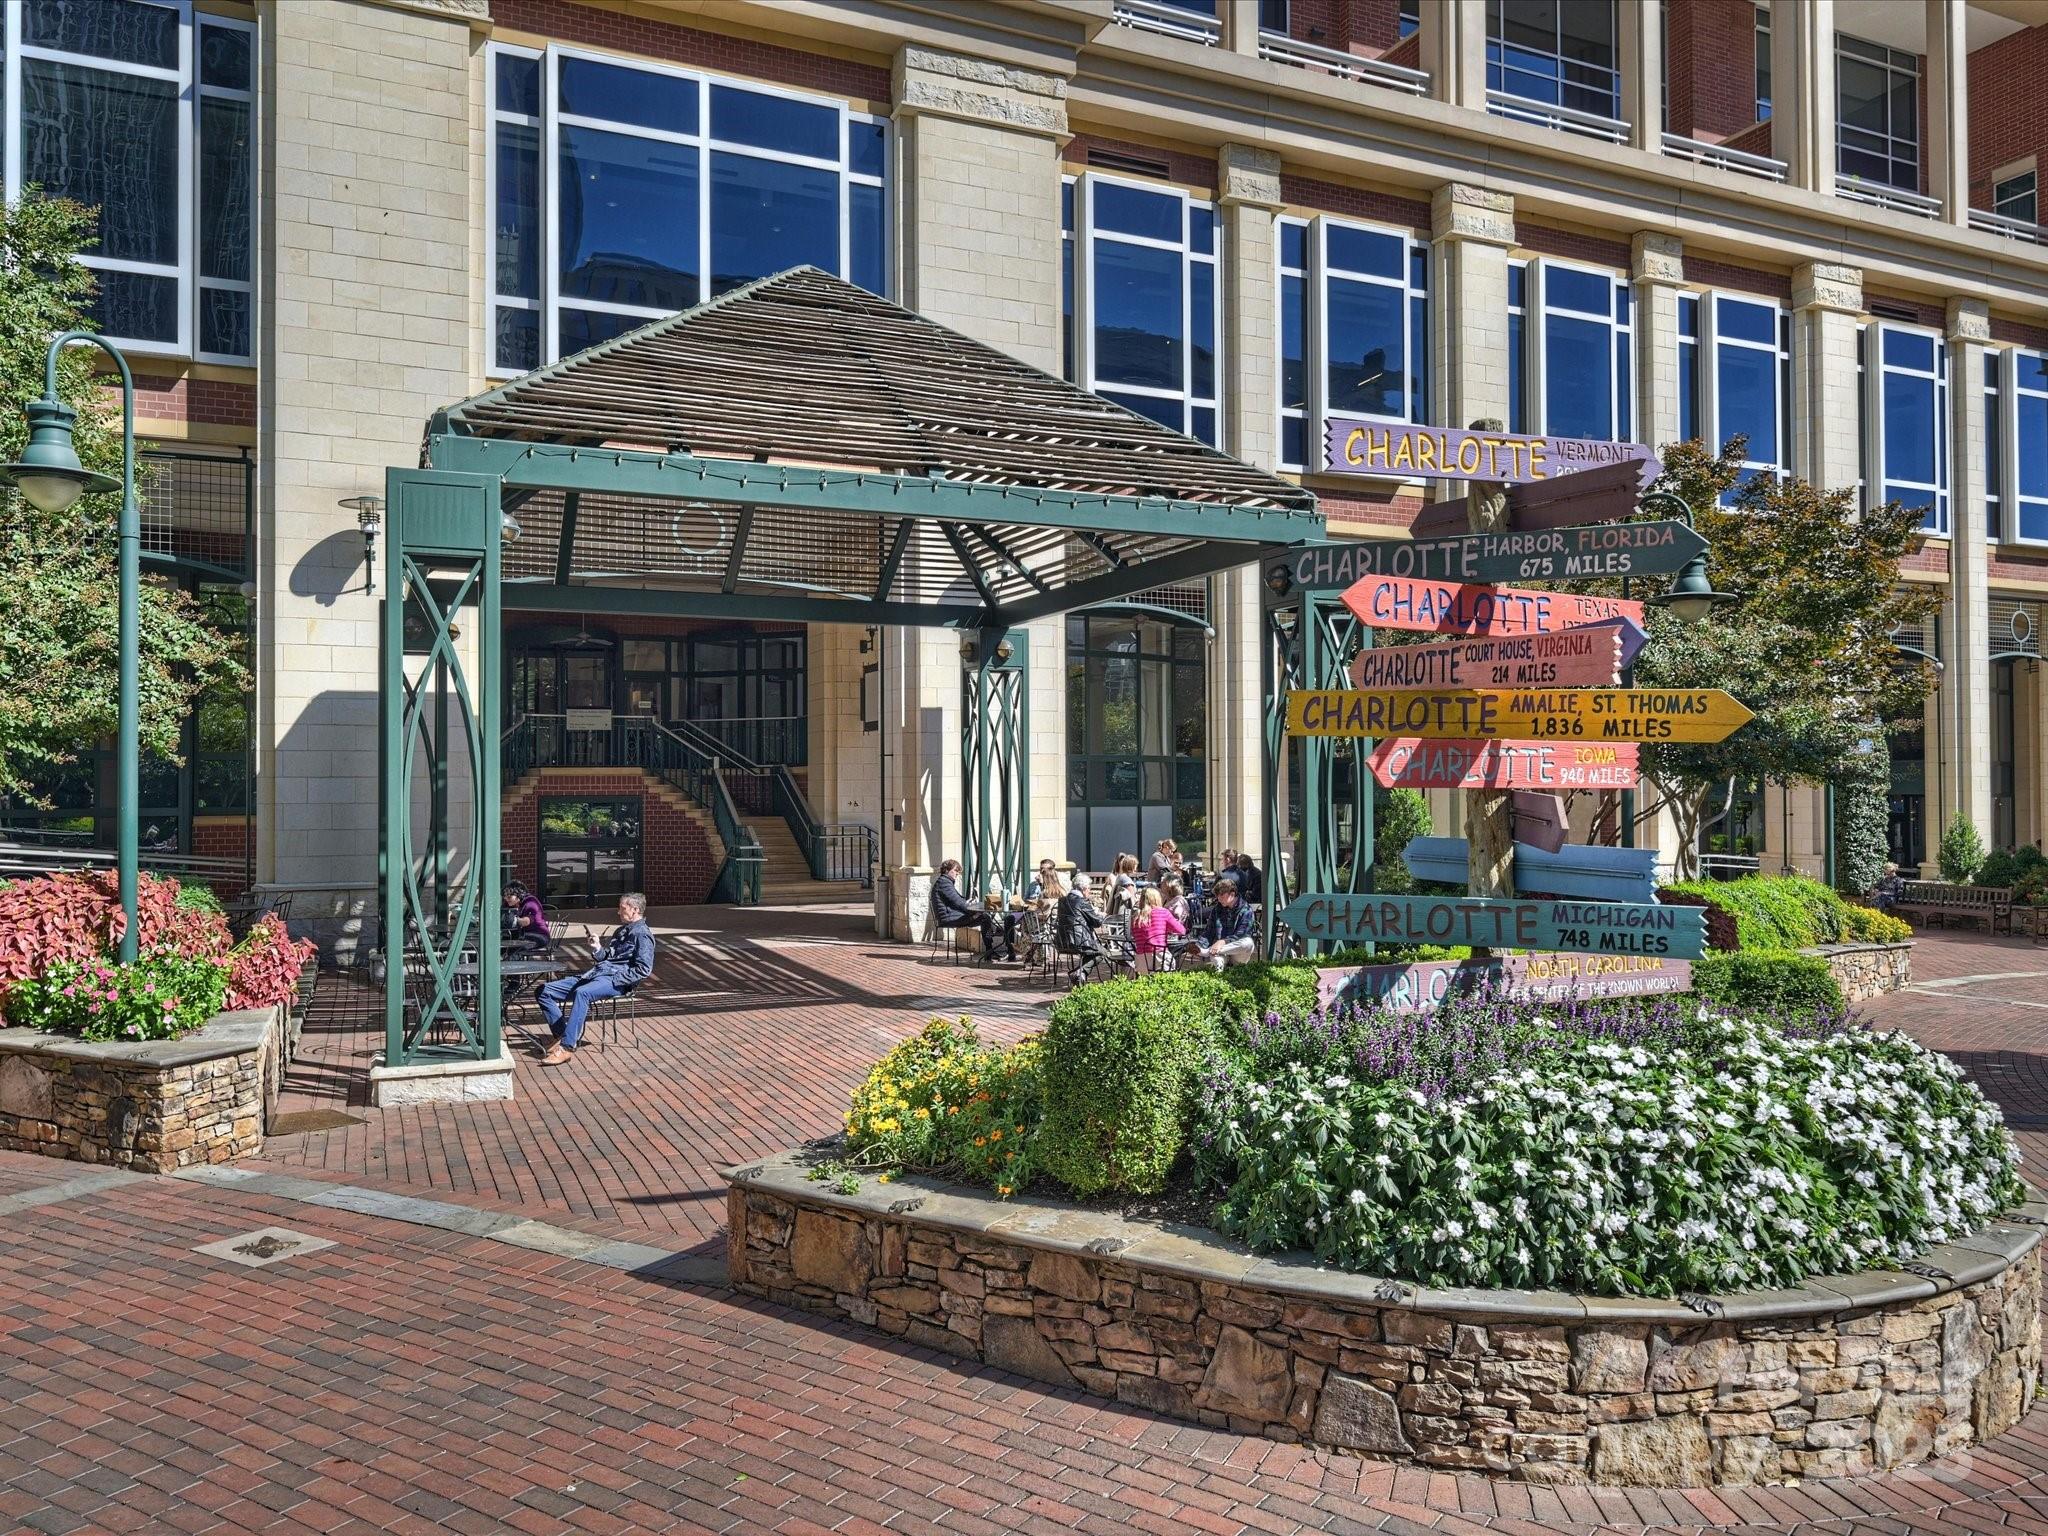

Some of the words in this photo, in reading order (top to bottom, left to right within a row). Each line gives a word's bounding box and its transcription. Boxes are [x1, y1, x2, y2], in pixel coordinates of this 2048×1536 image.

[1345, 426, 1547, 480] CHARLOTTE
[1556, 440, 1635, 463] VERMONT
[1296, 537, 1480, 585] CHARLOTTE
[1483, 533, 1570, 557] HARBOR,
[1578, 526, 1675, 551] FLORIDA
[1519, 557, 1554, 578] 675
[1565, 553, 1632, 576] MILES
[1373, 583, 1552, 634] CHARLOTTE
[1574, 598, 1620, 618] TEXAS
[1363, 645, 1463, 687] CHARLOTTE
[1465, 642, 1495, 662] COURT
[1499, 638, 1536, 662] HOUSE,
[1537, 634, 1592, 657] VIRGINIA
[1492, 666, 1510, 684] 214
[1516, 663, 1557, 683] MILES
[1302, 694, 1499, 734] CHARLOTTE
[1510, 693, 1583, 717] AMALIE,
[1591, 694, 1617, 714] ST.
[1627, 694, 1708, 714] THOMAS
[1531, 717, 1584, 738] 1,836
[1602, 719, 1672, 738] MILES
[1388, 745, 1556, 783] CHARLOTTE
[1575, 746, 1617, 765] IOWA
[1560, 767, 1585, 785] 940
[1588, 767, 1631, 785] MILES
[1305, 899, 1539, 945] CHARLOTTE
[1551, 904, 1675, 930] MICHIGAN
[1557, 928, 1591, 949] 748
[1599, 931, 1669, 954] MILES
[1526, 957, 1580, 981] NORTH
[1585, 955, 1664, 976] CAROLINA
[1607, 978, 1643, 994] KNOWN
